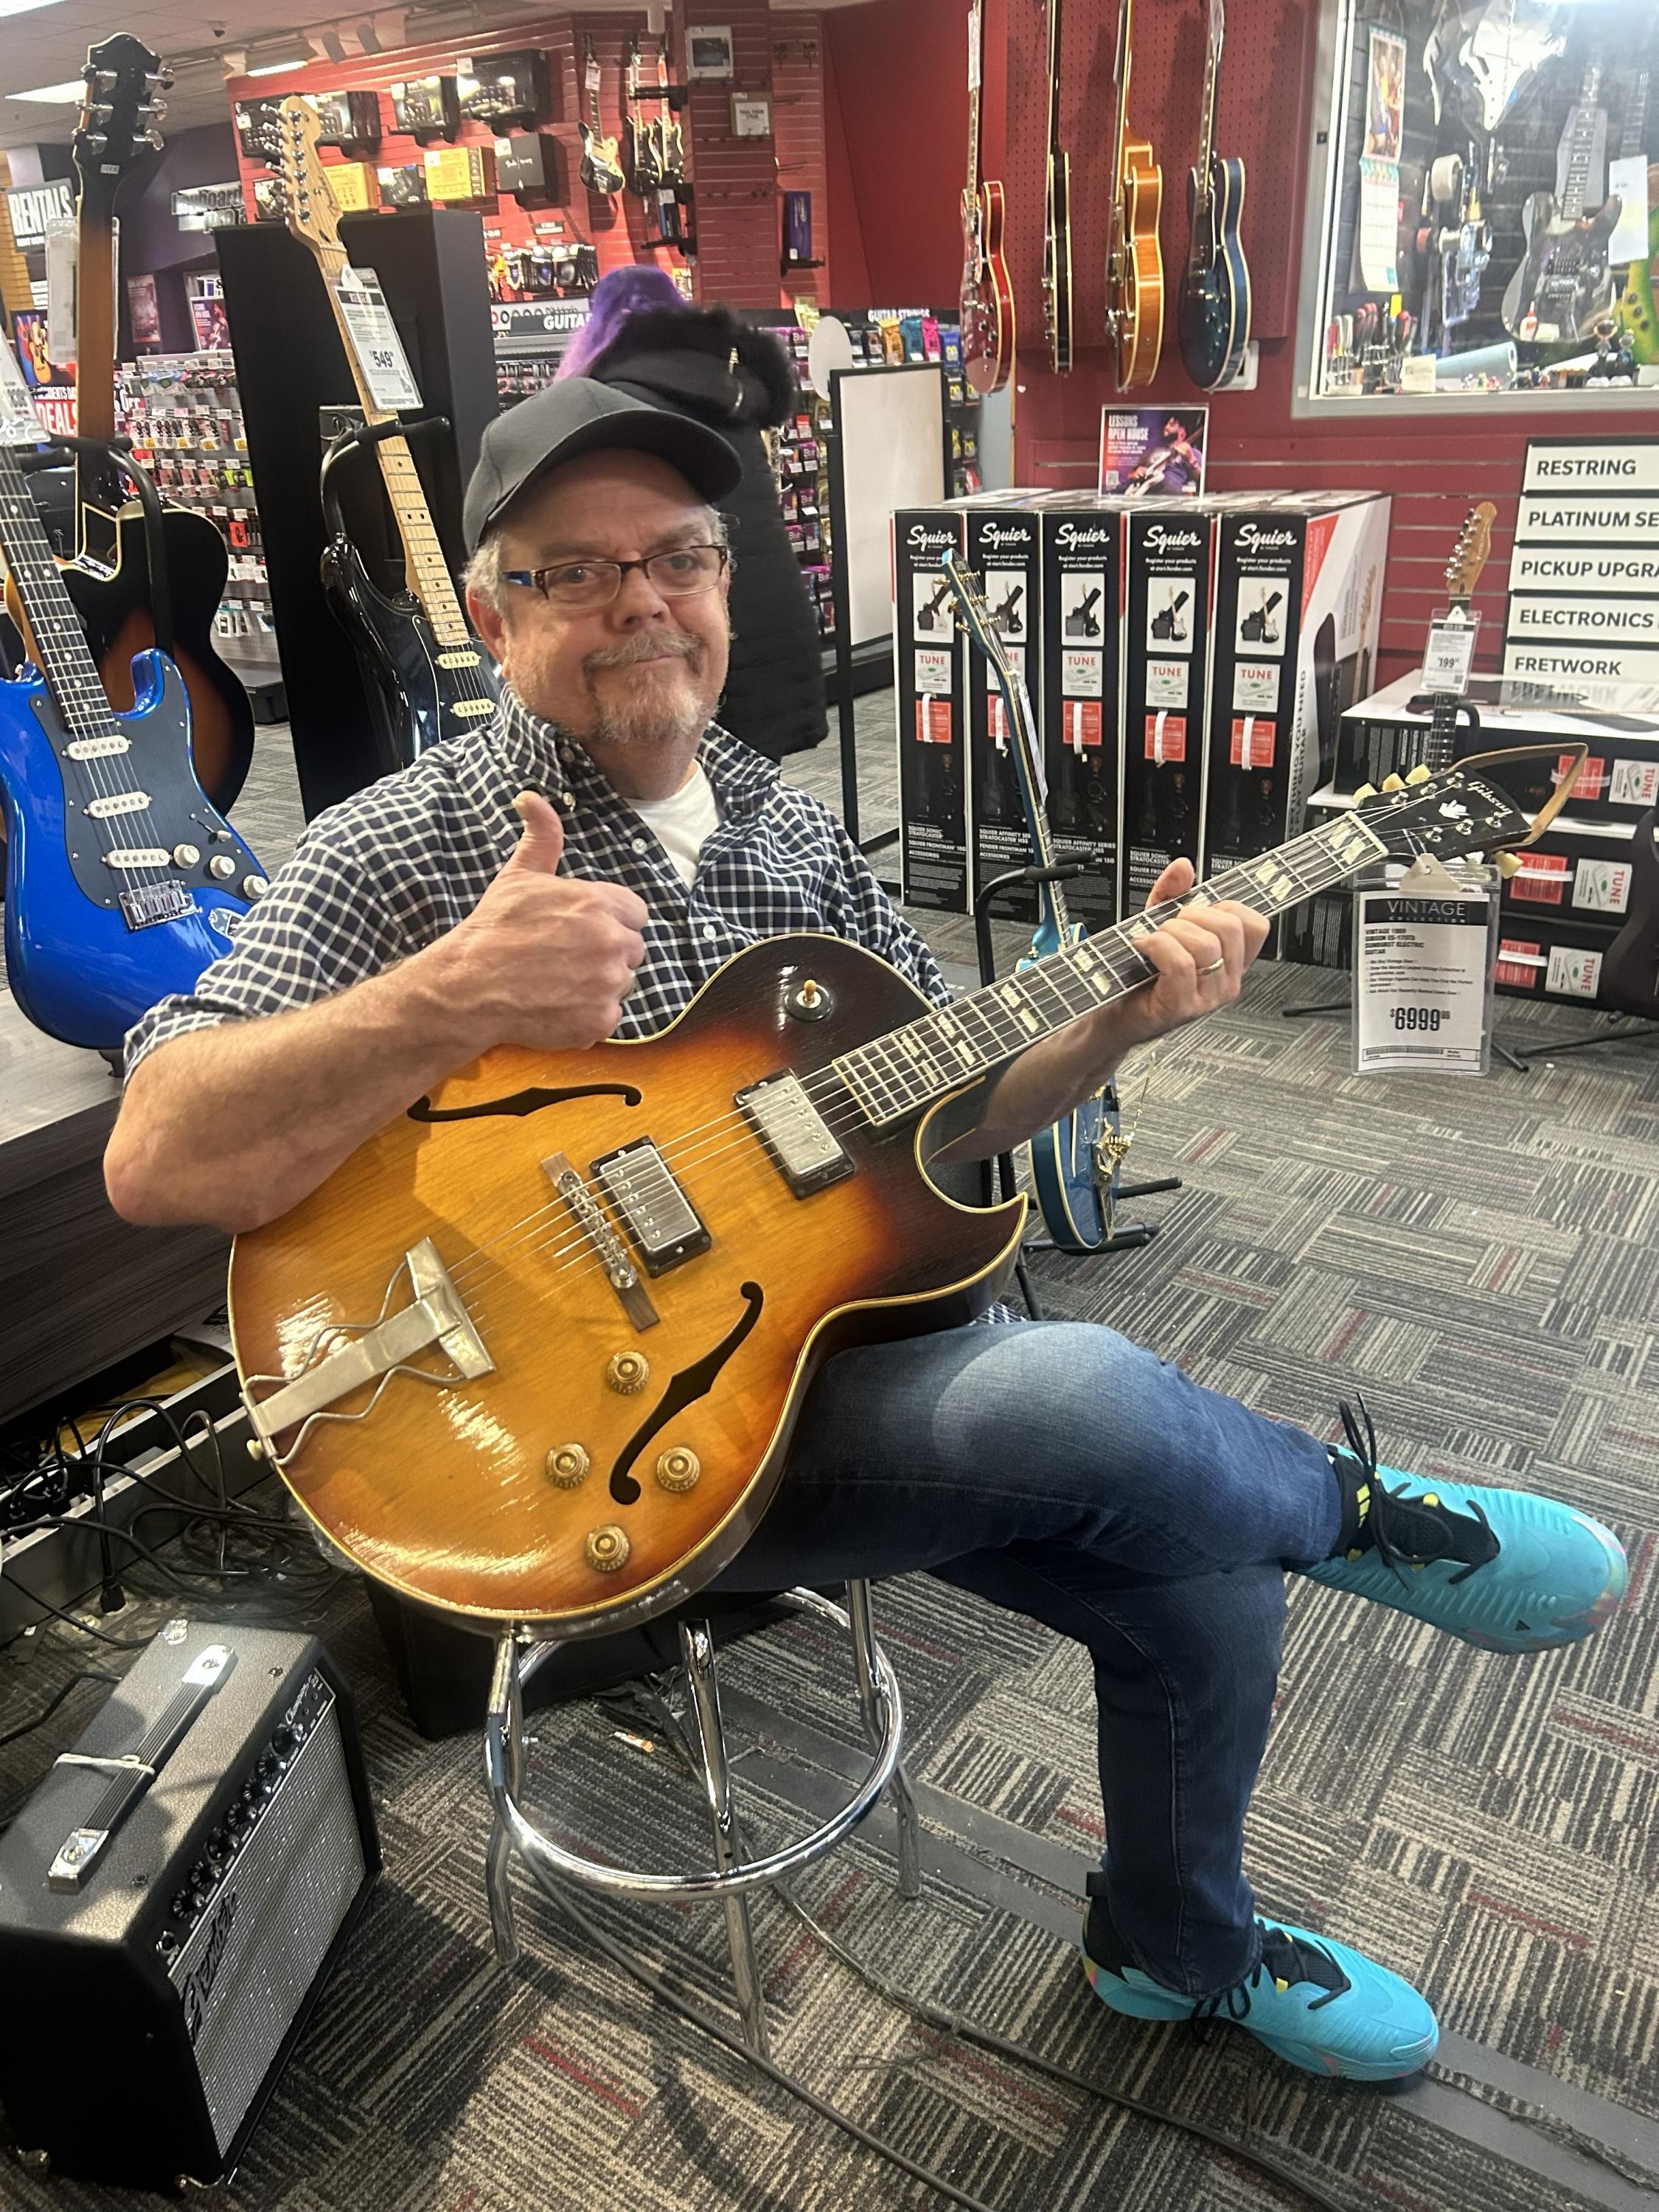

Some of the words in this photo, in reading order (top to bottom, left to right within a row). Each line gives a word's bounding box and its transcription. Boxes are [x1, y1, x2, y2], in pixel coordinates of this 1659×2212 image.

[7, 184, 73, 235] RENTALS
[1108, 414, 1138, 428] LESSONS
[1107, 428, 1126, 440] OPEN
[1127, 428, 1149, 440] HOUSE
[1537, 459, 1637, 476] RESTRING
[1528, 511, 1630, 527] PLATINUM
[1635, 512, 1659, 527] SE
[906, 525, 958, 552] Squier
[978, 523, 1032, 549] Squier
[1054, 524, 1110, 552] Squier
[1142, 525, 1201, 554] Squier
[1234, 524, 1297, 554] Squier
[1520, 560, 1593, 576] PICKUP
[1520, 609, 1654, 627] ELECTRONICS
[919, 655, 945, 665] TUNE
[1068, 656, 1096, 666] TUNE
[1514, 656, 1622, 675] FRETWORK
[1152, 667, 1181, 676] TUNE
[1241, 669, 1273, 680] TUNE
[1298, 670, 1306, 712] NEED
[1295, 717, 1303, 751] YOU
[1297, 728, 1307, 785] GUITAR
[1641, 768, 1655, 799] TUNE
[1467, 781, 1514, 818] Gibson
[908, 849, 940, 858] ACCESSORIES
[1130, 849, 1149, 858] SQUIER
[1211, 857, 1232, 865] SQUIER
[1130, 866, 1150, 874] SQUIER
[1609, 871, 1625, 905] TUNE
[1387, 900, 1466, 916] VINTAGE
[1580, 959, 1596, 992] TUNE
